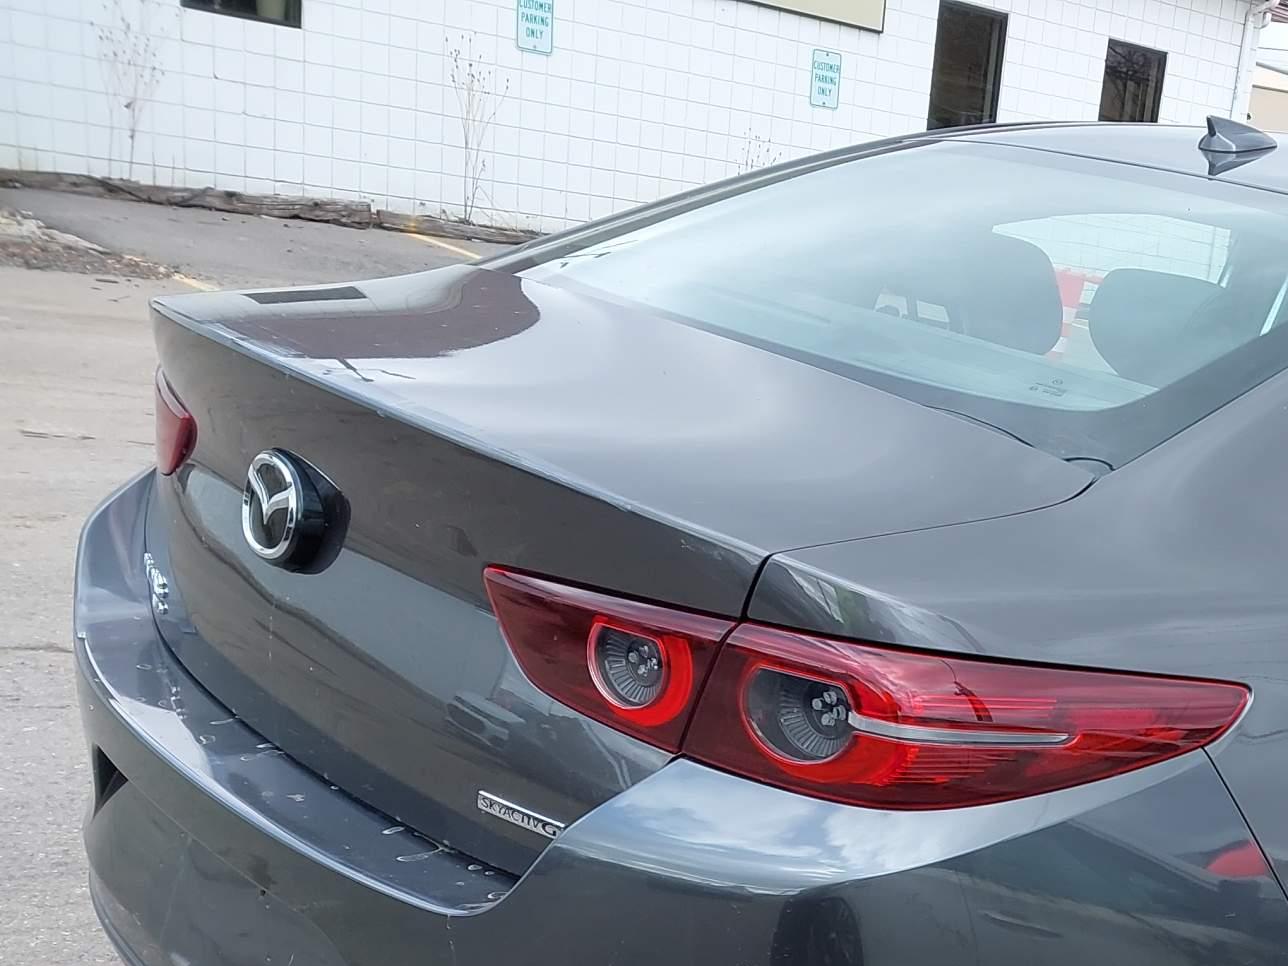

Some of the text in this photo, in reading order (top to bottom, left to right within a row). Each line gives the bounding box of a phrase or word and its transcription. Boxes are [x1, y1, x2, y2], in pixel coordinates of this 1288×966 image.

[520, 0, 552, 13] CUSTOMER
[521, 11, 549, 27] PARKING
[525, 27, 544, 40] ONLY
[813, 60, 840, 73] CUSTOMER
[815, 72, 837, 86] PARKING
[817, 86, 832, 97] ONLY
